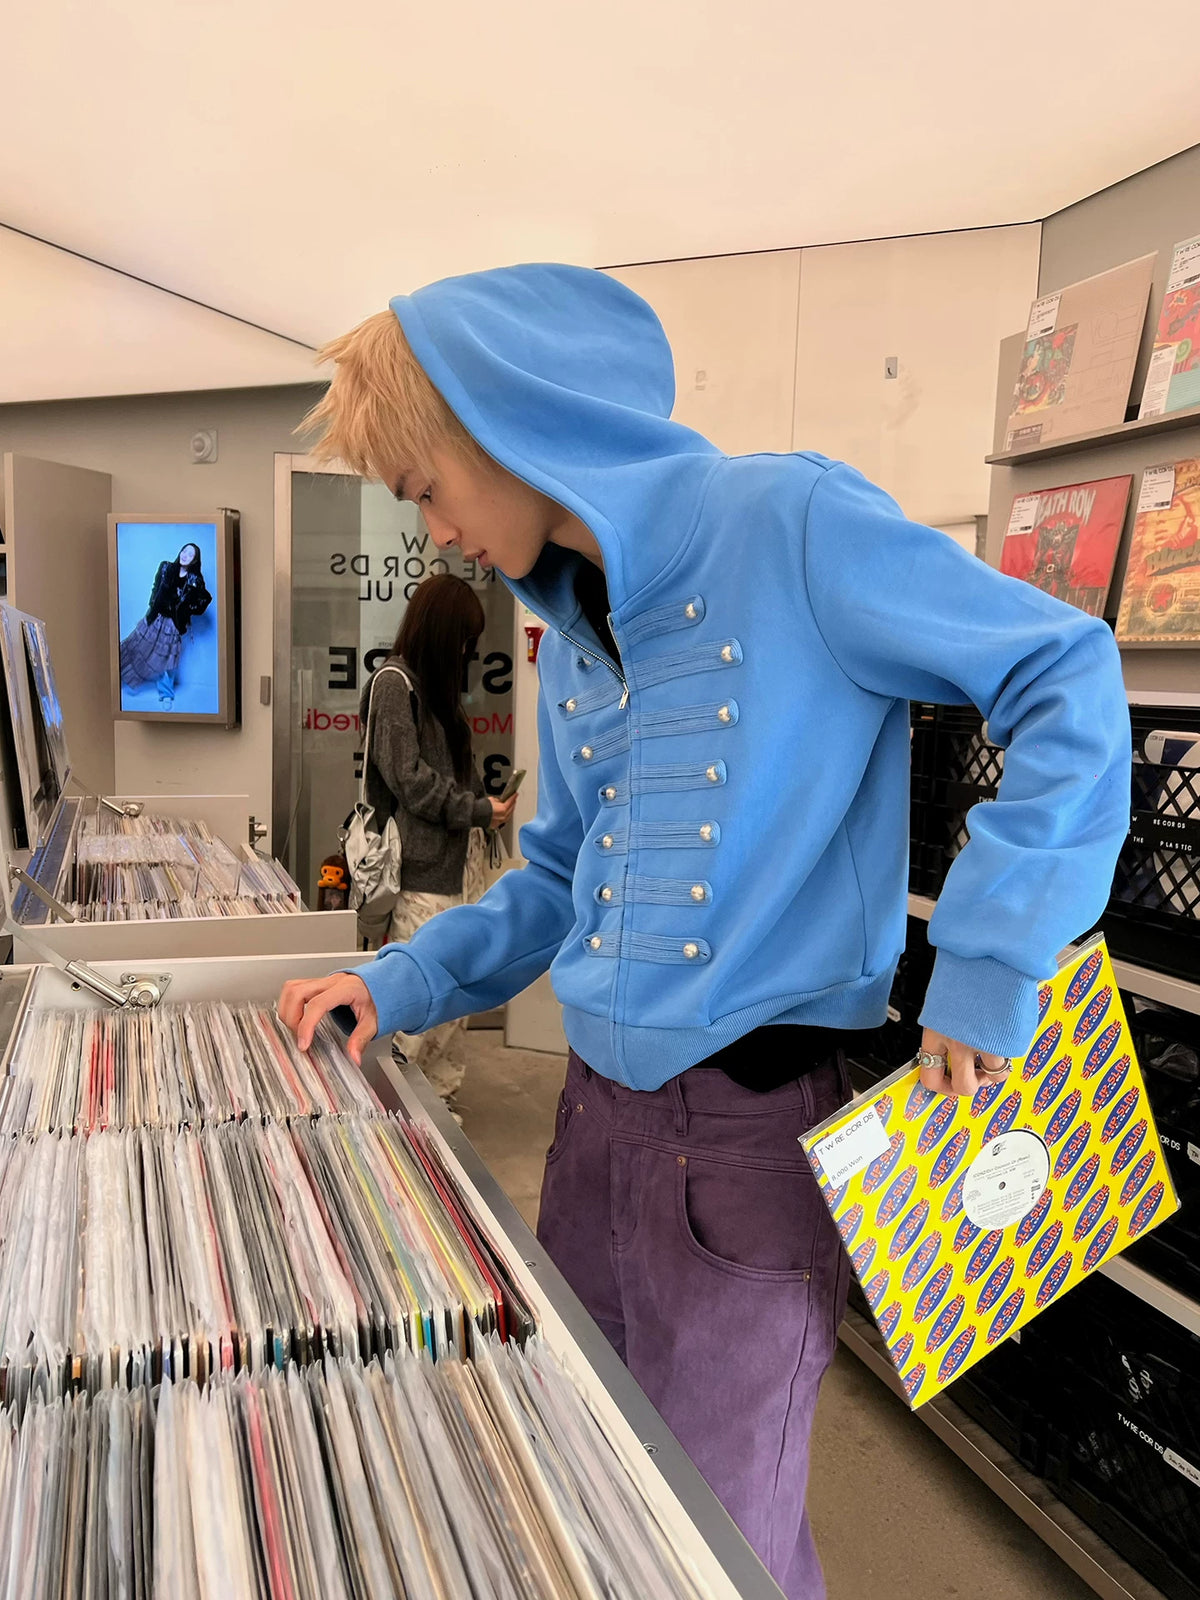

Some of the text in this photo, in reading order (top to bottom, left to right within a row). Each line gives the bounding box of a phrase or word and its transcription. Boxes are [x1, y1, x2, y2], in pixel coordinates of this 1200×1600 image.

[1068, 489, 1096, 527] ROW
[1170, 1139, 1181, 1151] DS
[1117, 1412, 1122, 1421] T
[1122, 1416, 1131, 1427] W
[1139, 1430, 1154, 1447] COR
[1154, 1441, 1164, 1455] DS
